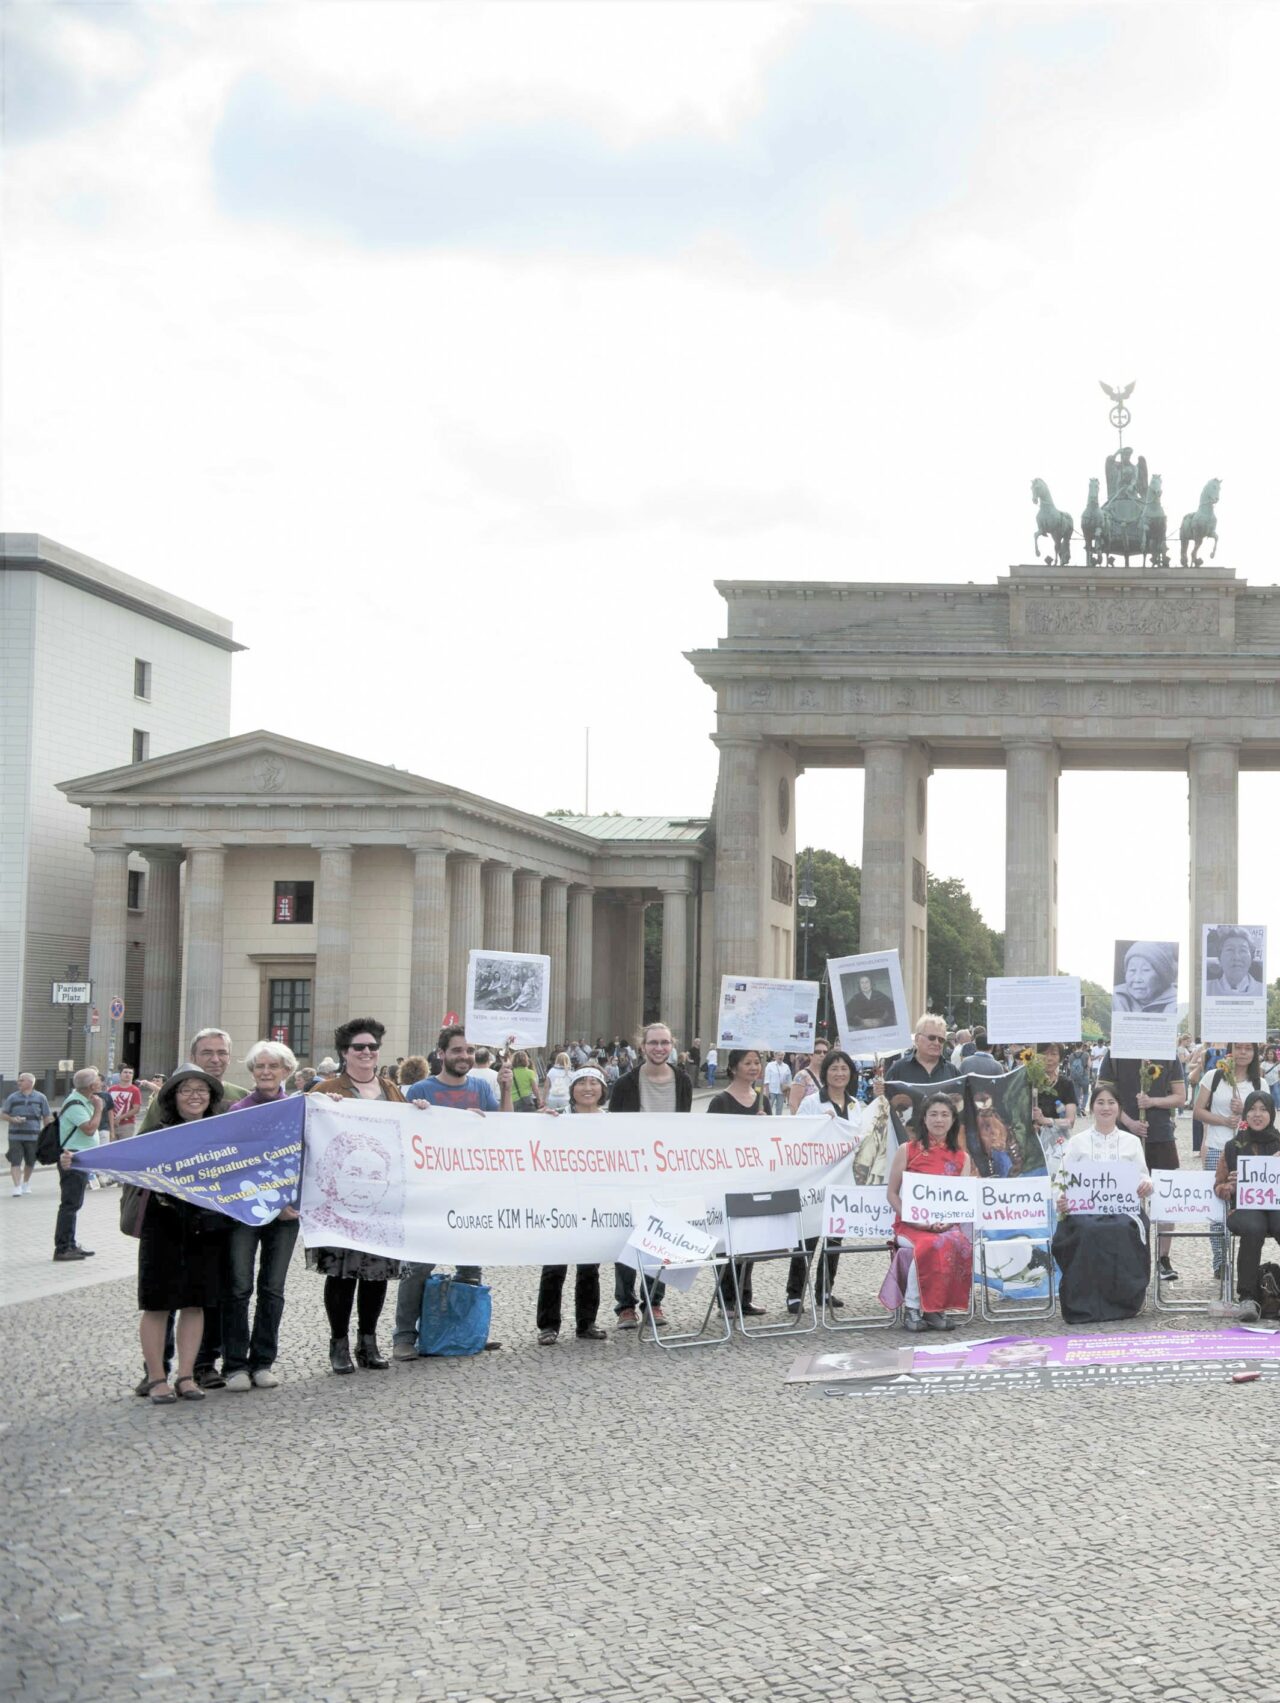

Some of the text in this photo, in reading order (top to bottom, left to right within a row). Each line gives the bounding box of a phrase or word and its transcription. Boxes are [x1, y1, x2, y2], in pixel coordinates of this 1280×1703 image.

[57, 984, 86, 993] Pariser
[61, 993, 81, 1001] Platz
[175, 1145, 239, 1171] participate
[411, 1134, 526, 1172] SEXUALISIERTE
[653, 1140, 733, 1173] SCHICKSAL
[735, 1146, 763, 1168] DER
[198, 1156, 261, 1179] Signatures
[209, 1181, 221, 1192] of
[1070, 1171, 1117, 1189] North
[217, 1187, 257, 1203] Sexual
[912, 1184, 969, 1202] China
[982, 1186, 1044, 1206] Burma
[1091, 1190, 1135, 1203] Korea
[1159, 1178, 1213, 1206] Japan
[1239, 1187, 1276, 1206] 1634
[911, 1206, 929, 1223] 80
[982, 1206, 1046, 1222] unknown
[1069, 1199, 1096, 1212] 220
[1165, 1204, 1211, 1214] unknown
[447, 1209, 493, 1229] COURAGE
[497, 1208, 521, 1229] KIM
[829, 1216, 894, 1236] 12 registere
[647, 1215, 710, 1255] Thailand
[889, 1371, 1039, 1383] Against
[1051, 1362, 1247, 1376] militarized
[871, 1382, 981, 1391] apology
[908, 1386, 996, 1394] slaves
